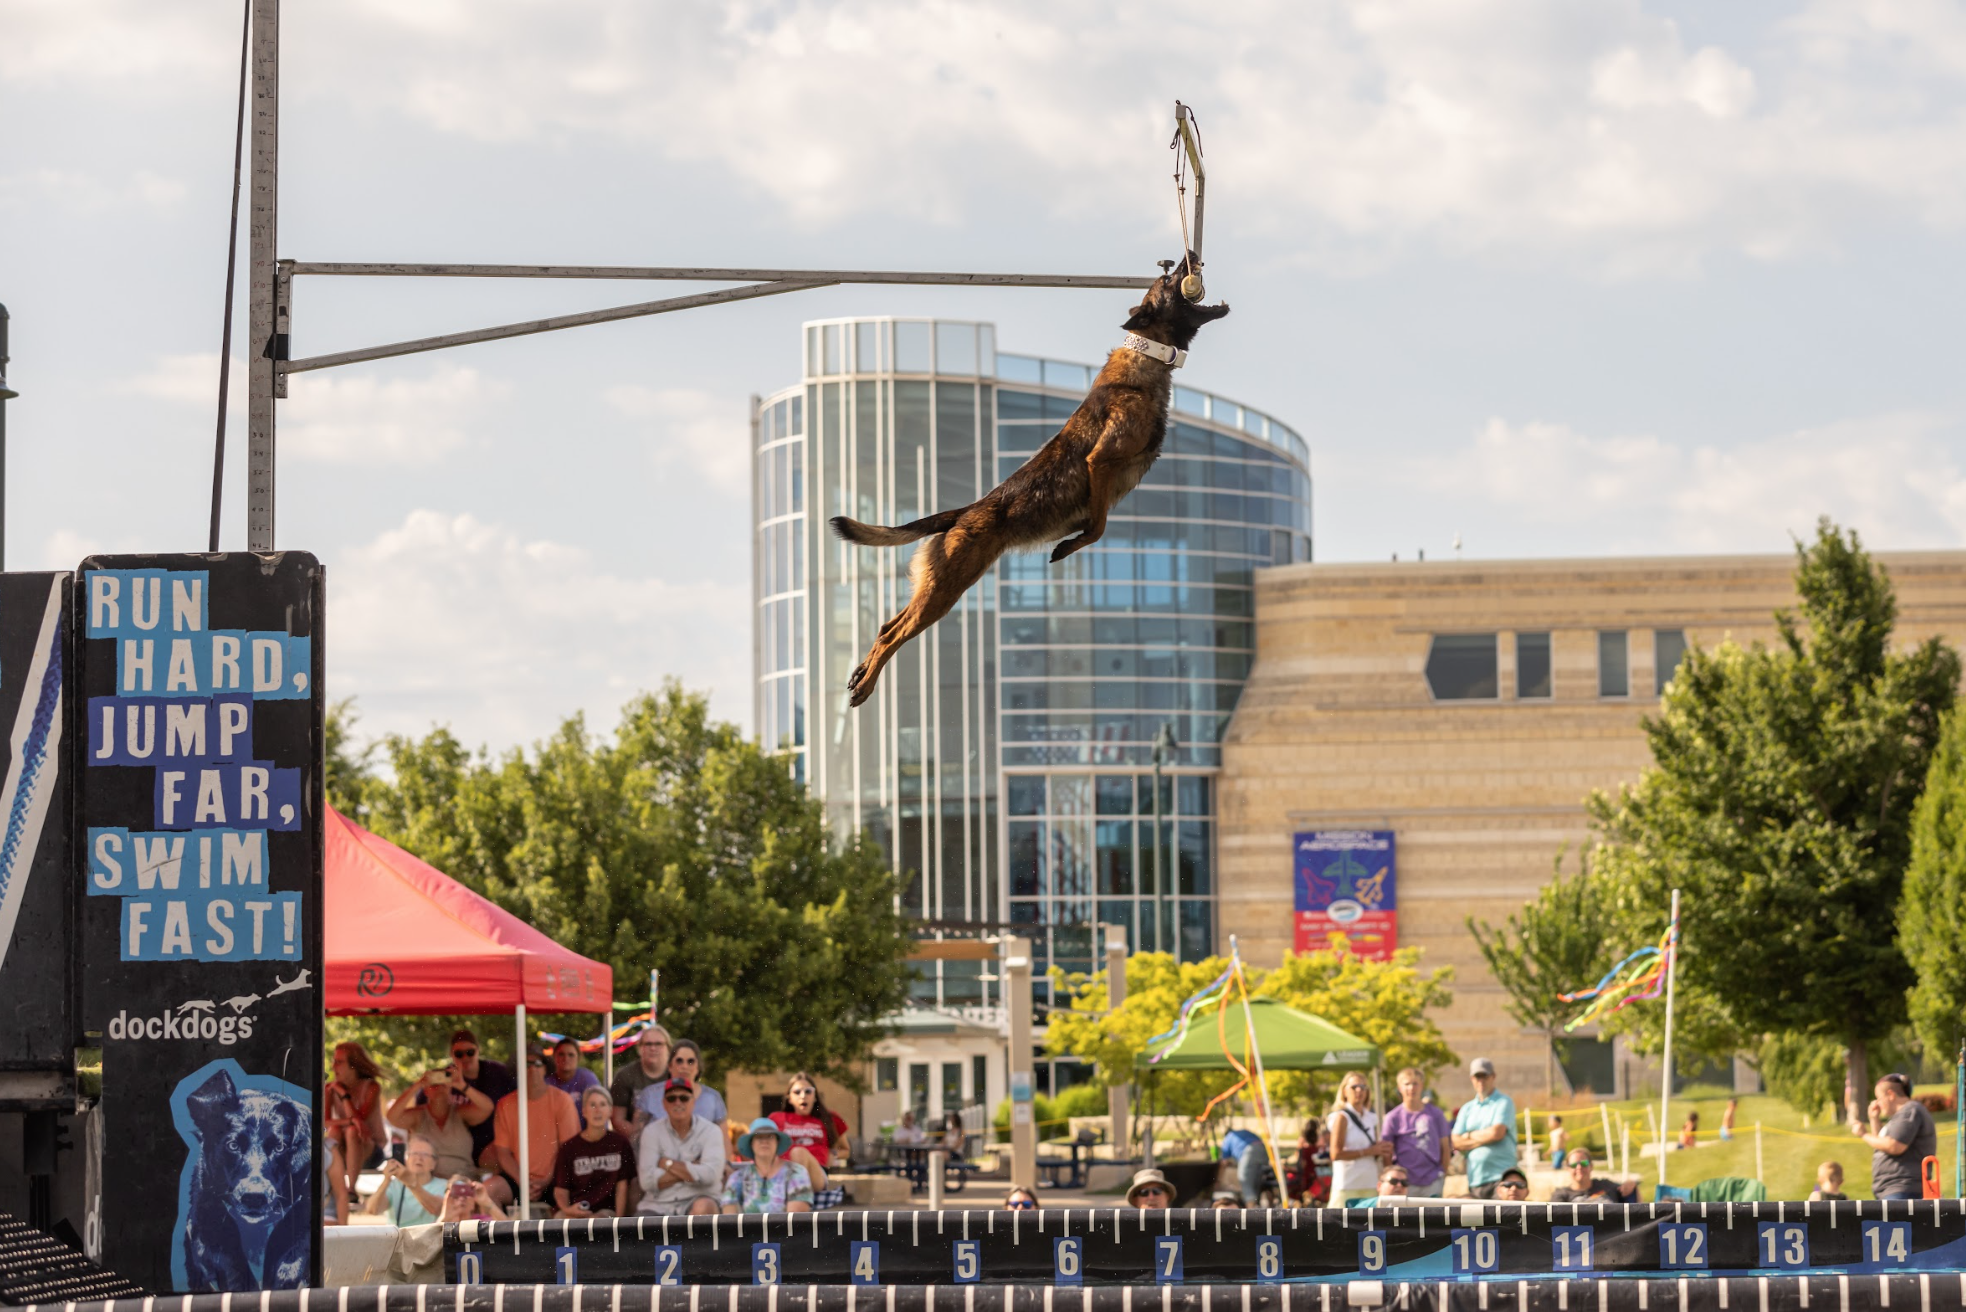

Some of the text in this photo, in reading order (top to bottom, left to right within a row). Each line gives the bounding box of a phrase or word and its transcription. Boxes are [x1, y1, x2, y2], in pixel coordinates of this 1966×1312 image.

[91, 575, 202, 632] RUN
[123, 635, 309, 693] HARD,
[96, 702, 249, 759] JUMP
[162, 766, 296, 825] FAR,
[94, 832, 263, 890] SWIM
[128, 899, 297, 957] FAST!
[109, 1009, 253, 1045] dockdogs
[956, 1242, 978, 1280] 5
[1057, 1239, 1079, 1276] 6
[1159, 1241, 1179, 1276] 7
[1259, 1241, 1280, 1278] 8
[1362, 1234, 1384, 1271] 9
[1453, 1232, 1497, 1271] 10
[1554, 1231, 1591, 1268] 11
[1661, 1227, 1704, 1265] 12
[1761, 1227, 1806, 1265] 13
[1864, 1226, 1908, 1263] 14
[460, 1253, 481, 1285] 0
[558, 1252, 574, 1285] 1
[659, 1249, 680, 1285] 2
[757, 1248, 780, 1284] 3
[854, 1245, 875, 1282] 4
